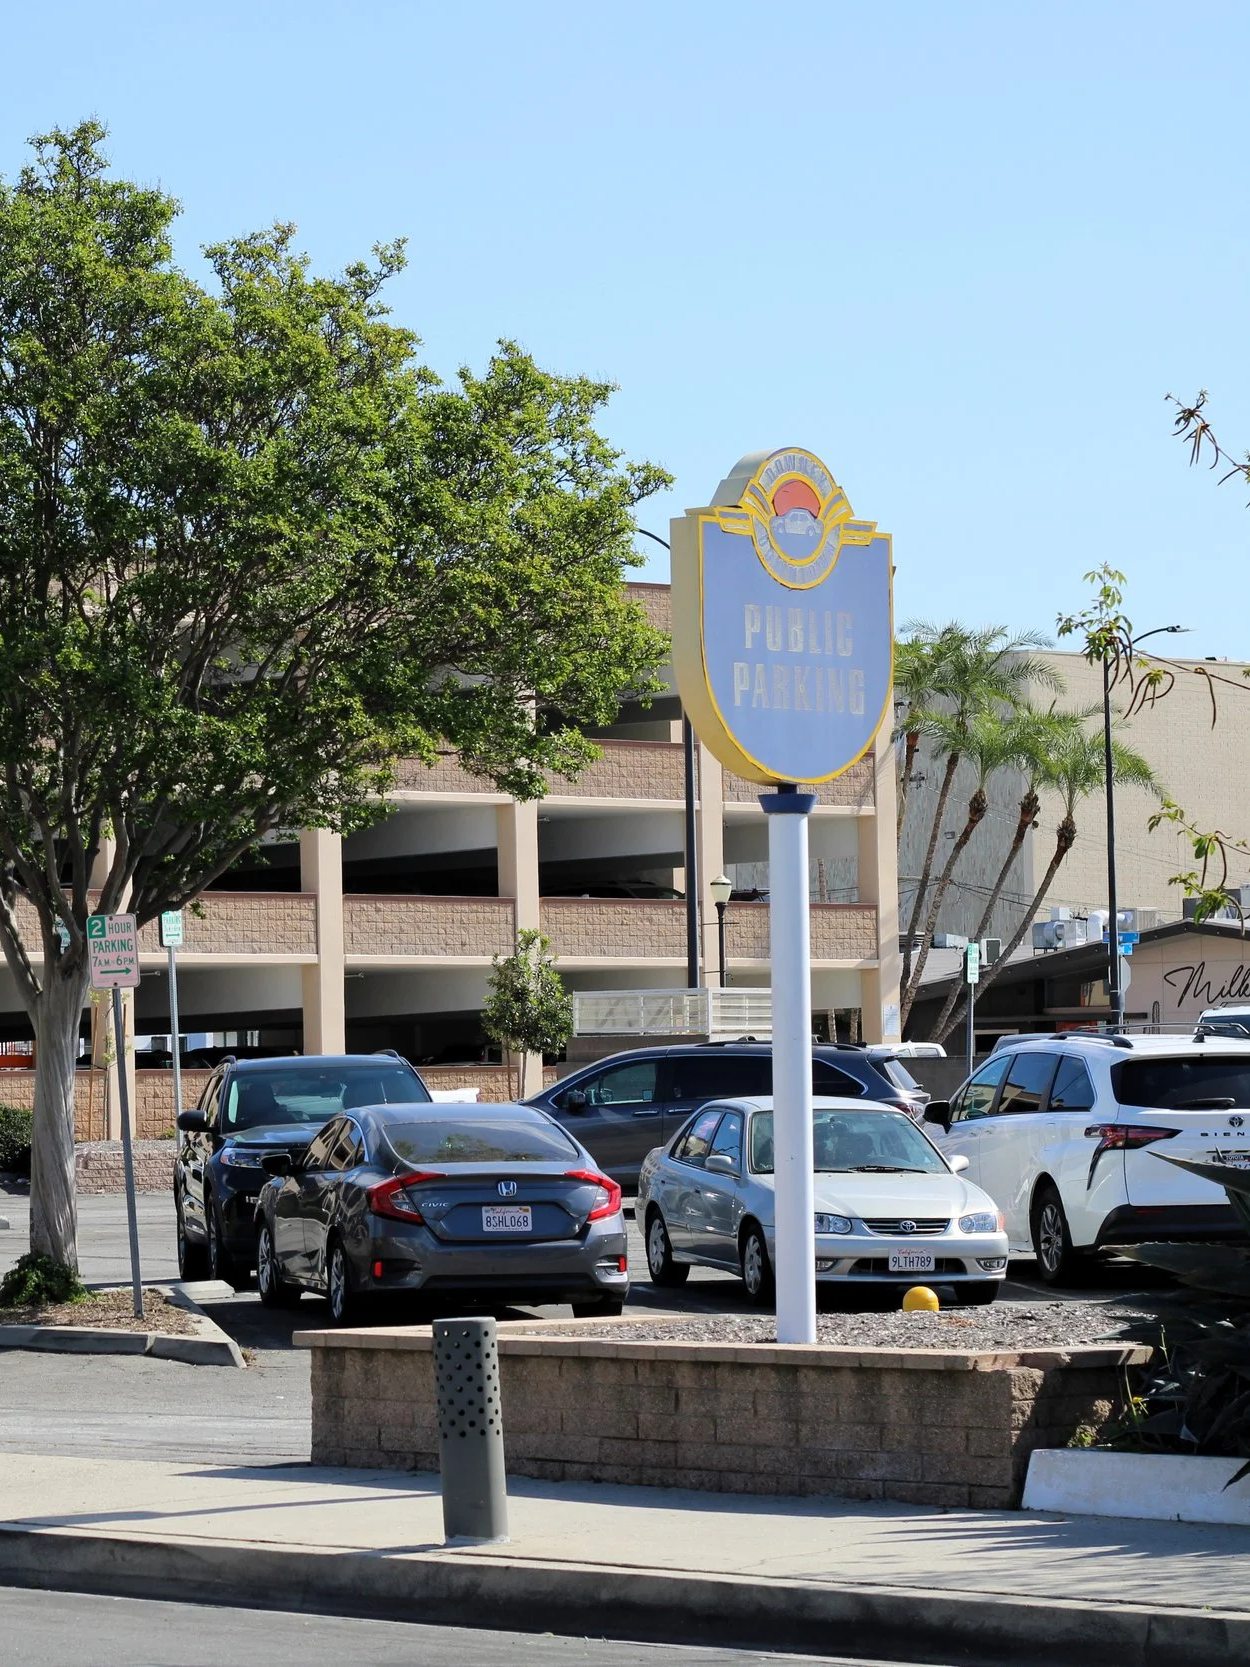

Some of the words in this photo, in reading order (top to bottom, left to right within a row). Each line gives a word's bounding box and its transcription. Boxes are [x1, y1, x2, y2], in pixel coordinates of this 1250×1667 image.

[765, 455, 829, 489] DOWNEY
[744, 604, 854, 657] PUBLIC
[733, 662, 866, 715] PARKING
[90, 919, 103, 936] 2
[108, 922, 132, 934] HOUR
[92, 939, 134, 953] PARKING
[492, 1207, 521, 1215] California
[485, 1215, 529, 1228] 8SHL068
[892, 1256, 932, 1268] 9LTH789
